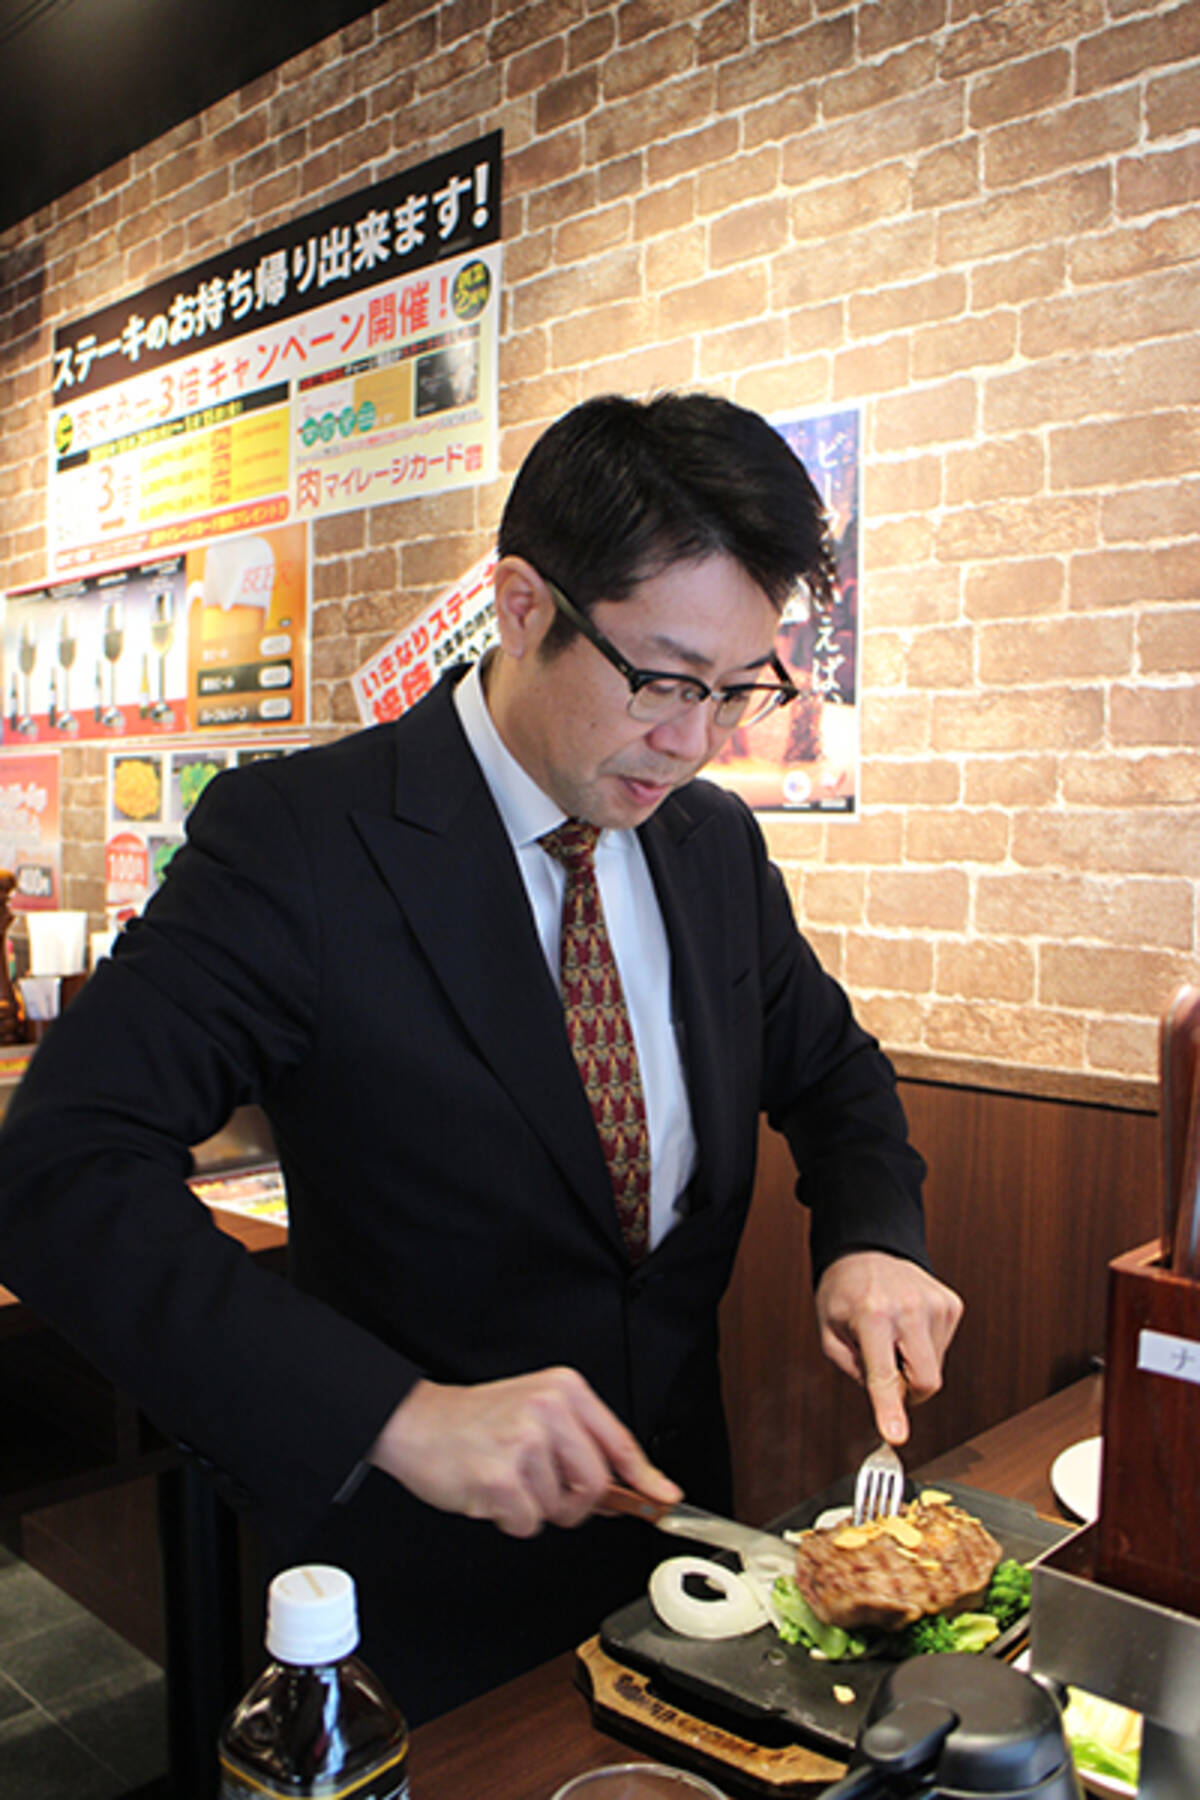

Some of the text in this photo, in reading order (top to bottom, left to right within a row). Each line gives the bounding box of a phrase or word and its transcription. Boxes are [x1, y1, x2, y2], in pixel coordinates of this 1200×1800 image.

[53, 162, 491, 392] ステーキのお持ち帰り出来ます!
